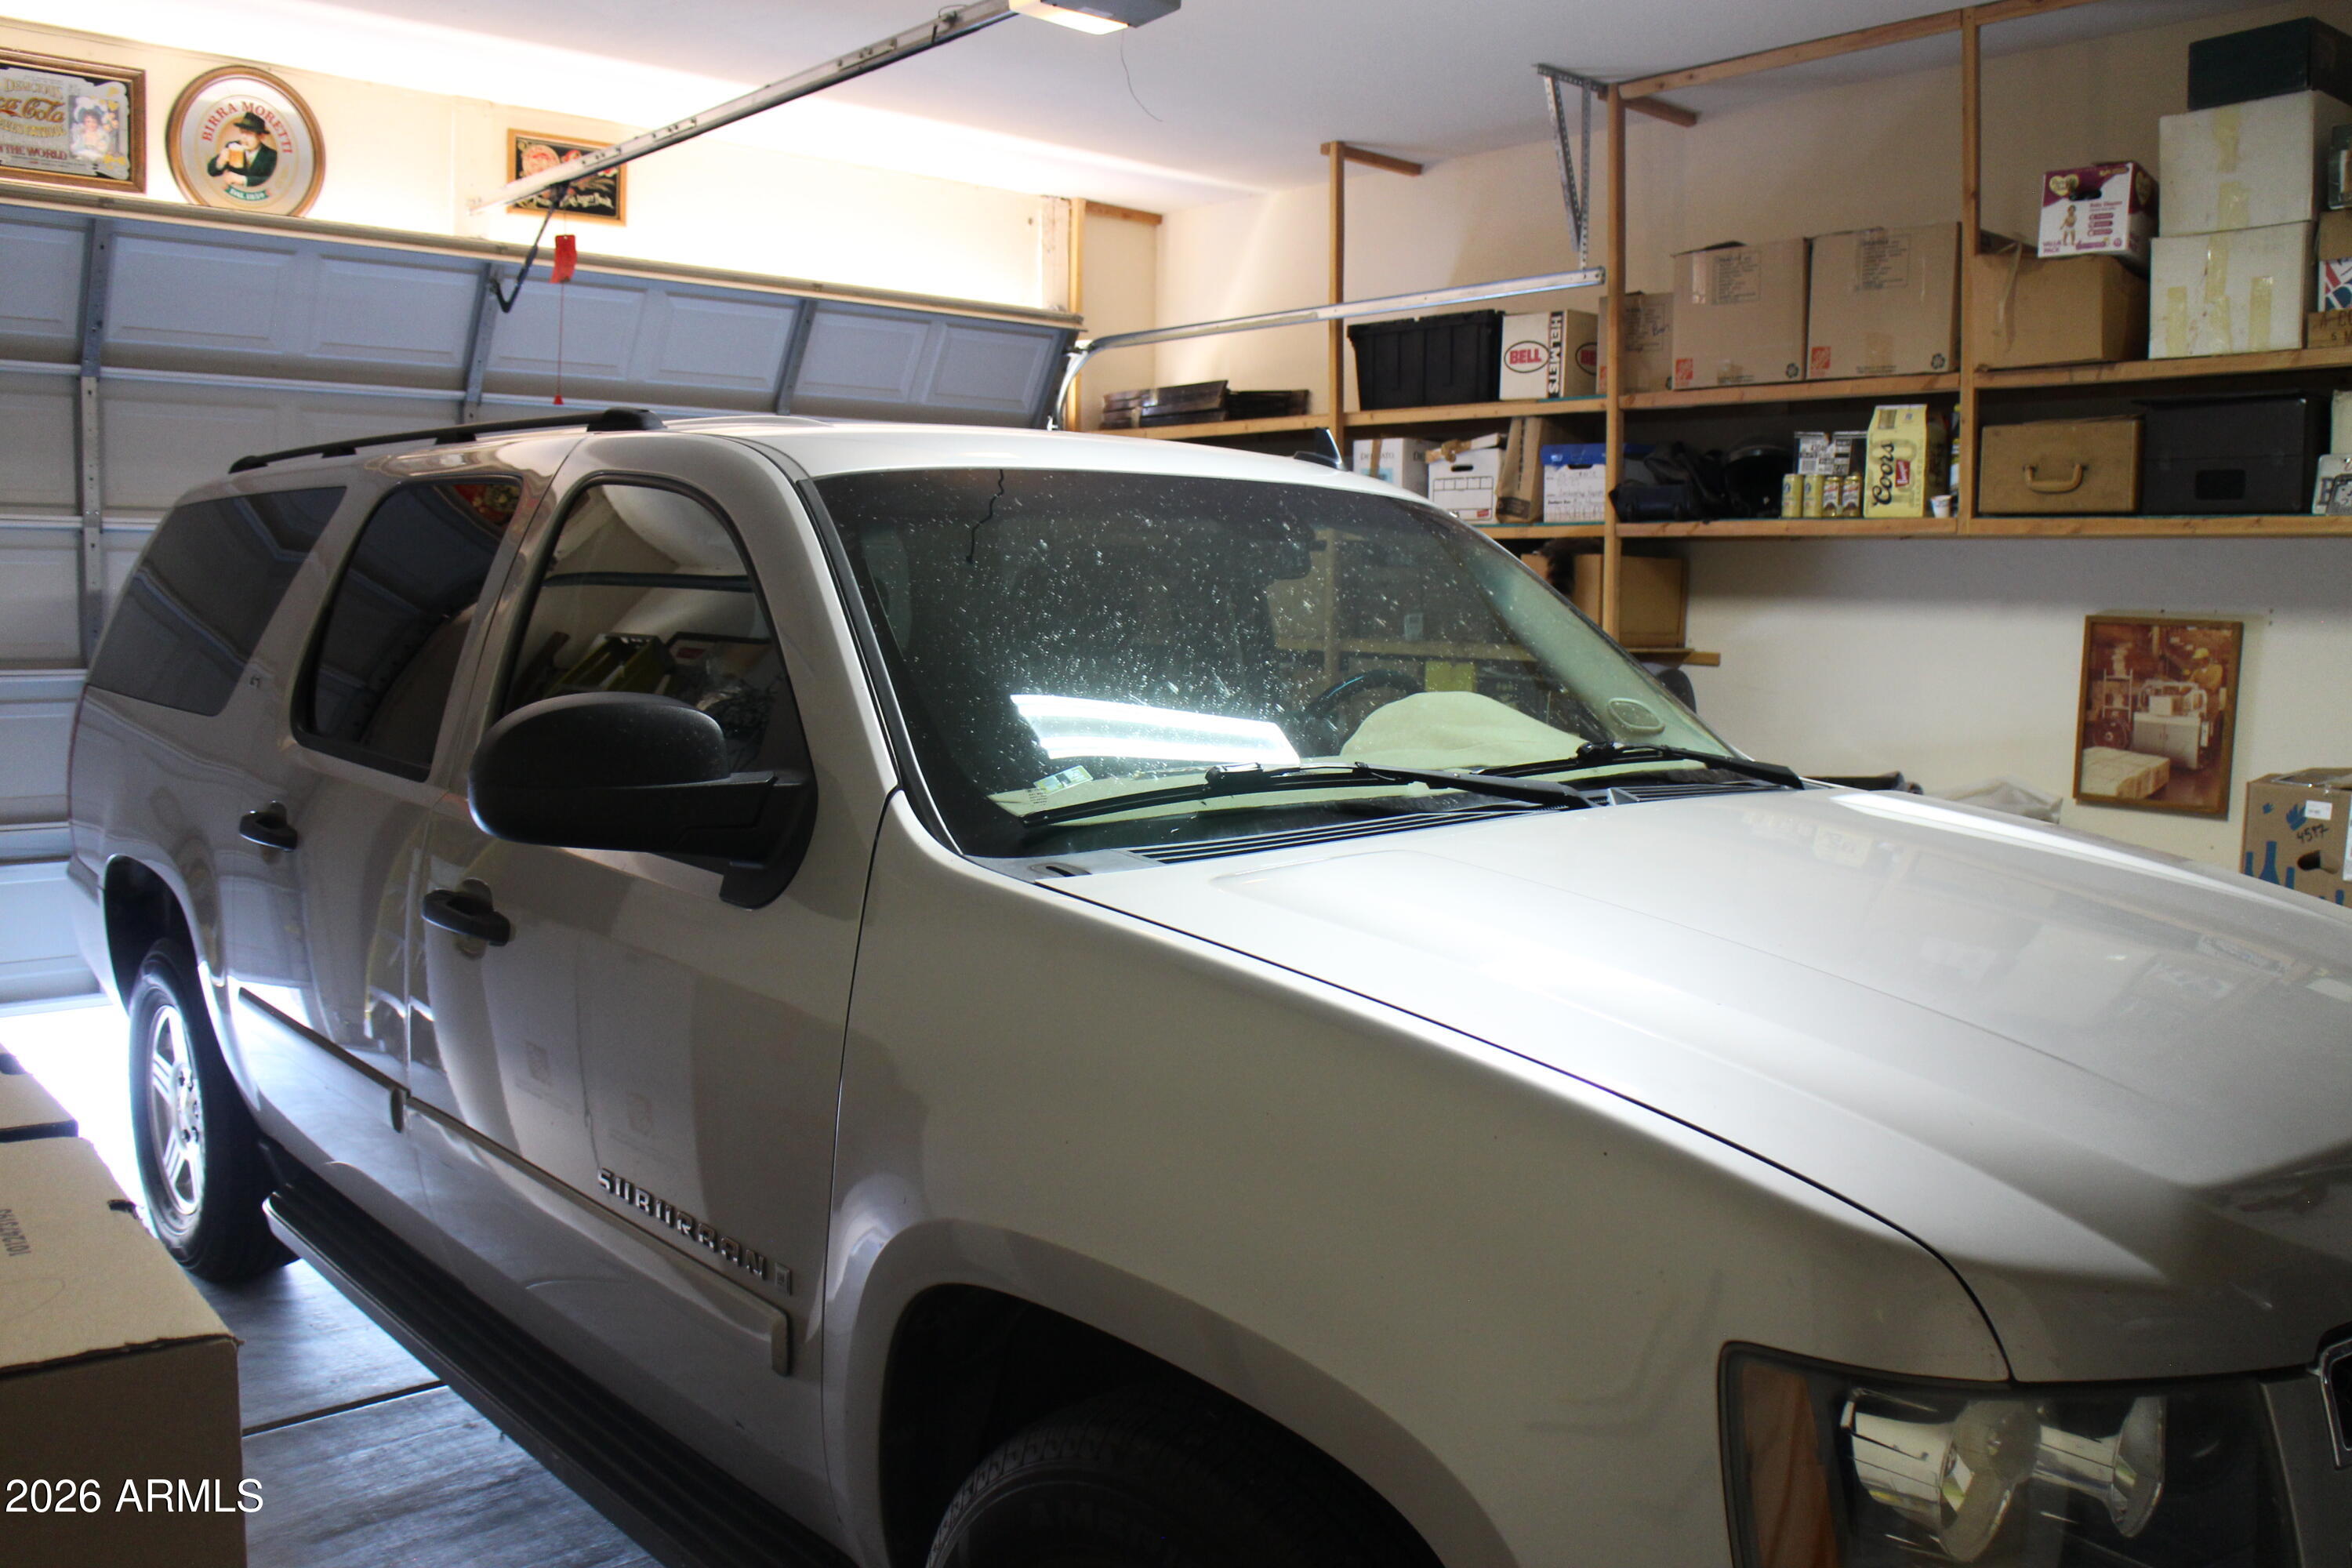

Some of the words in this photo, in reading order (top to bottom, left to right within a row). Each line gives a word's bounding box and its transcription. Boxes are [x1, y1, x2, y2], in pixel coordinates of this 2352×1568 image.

[27, 147, 67, 160] WORLD
[201, 103, 238, 143] BIRRA
[241, 100, 293, 154] MORETTI
[1509, 348, 1543, 365] BELL
[1548, 314, 1563, 394] HELMETS
[1871, 442, 1894, 507] Coors
[597, 1167, 767, 1280] SUBURBAN
